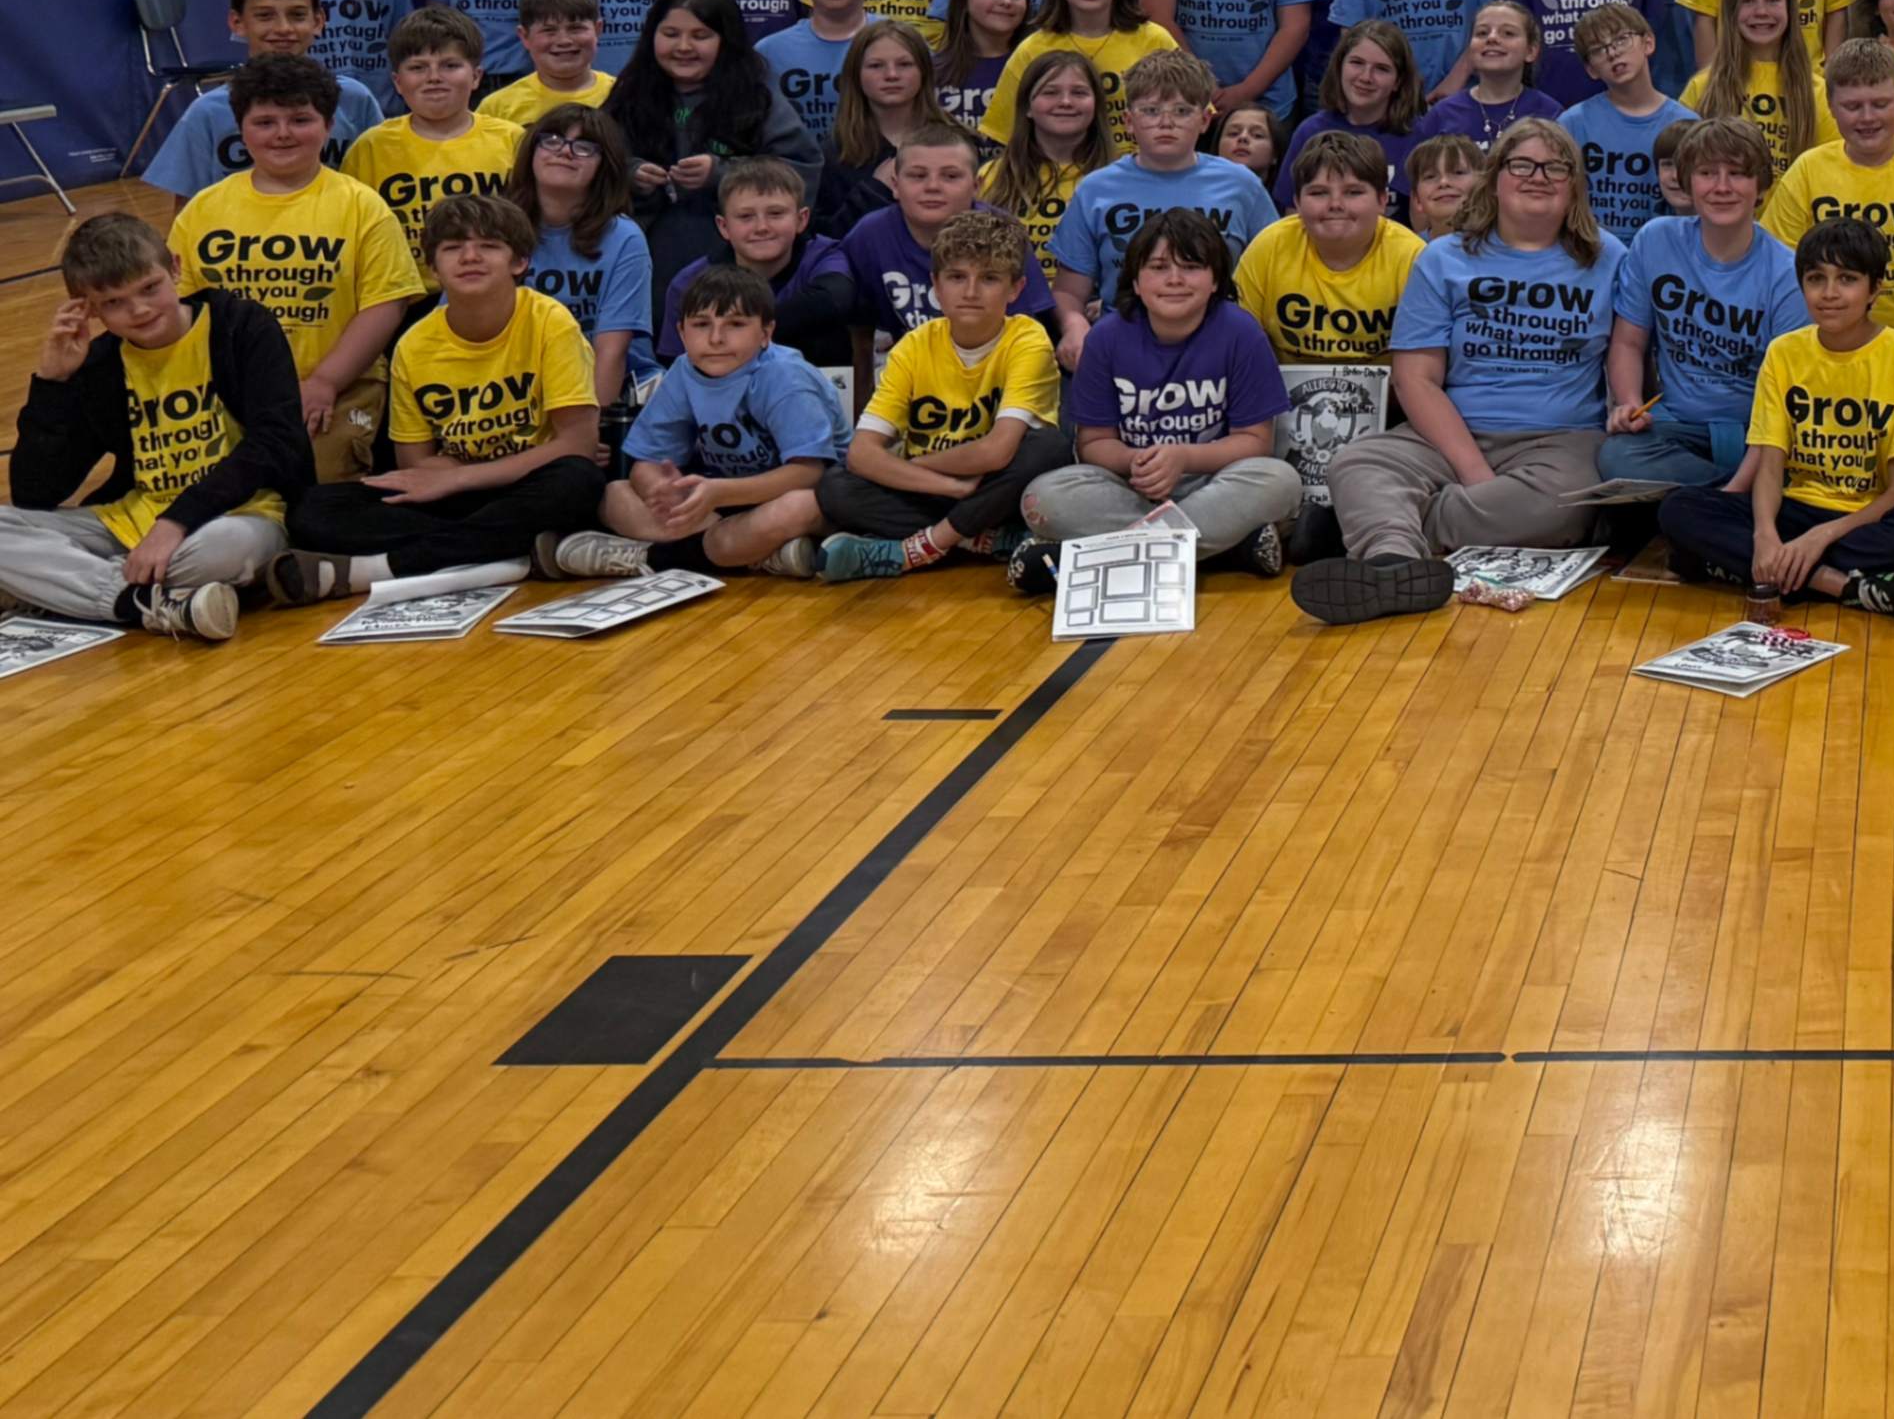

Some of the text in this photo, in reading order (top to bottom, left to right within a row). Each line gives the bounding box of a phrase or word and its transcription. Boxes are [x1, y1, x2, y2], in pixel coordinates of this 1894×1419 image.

[610, 6, 641, 18] you
[880, 2, 927, 16] throu
[1216, 0, 1245, 14] you
[1542, 11, 1579, 25] what
[1201, 13, 1268, 31] through
[1584, 142, 1655, 176] Gro
[379, 171, 512, 208] Grow
[1595, 179, 1662, 199] throug
[1619, 198, 1649, 214] you
[1603, 212, 1650, 228] throu
[199, 229, 345, 265] Grow
[225, 263, 333, 285] through
[257, 286, 297, 301] you
[1468, 277, 1594, 315] Grow
[1277, 294, 1396, 335] Grow
[1652, 274, 1765, 336] Grow
[1493, 307, 1589, 335] through
[1465, 320, 1556, 348] what you
[1672, 318, 1755, 355] through
[1463, 342, 1580, 363] go through
[1113, 377, 1226, 413] Grow
[1125, 409, 1222, 433] through
[1831, 452, 1863, 472] you
